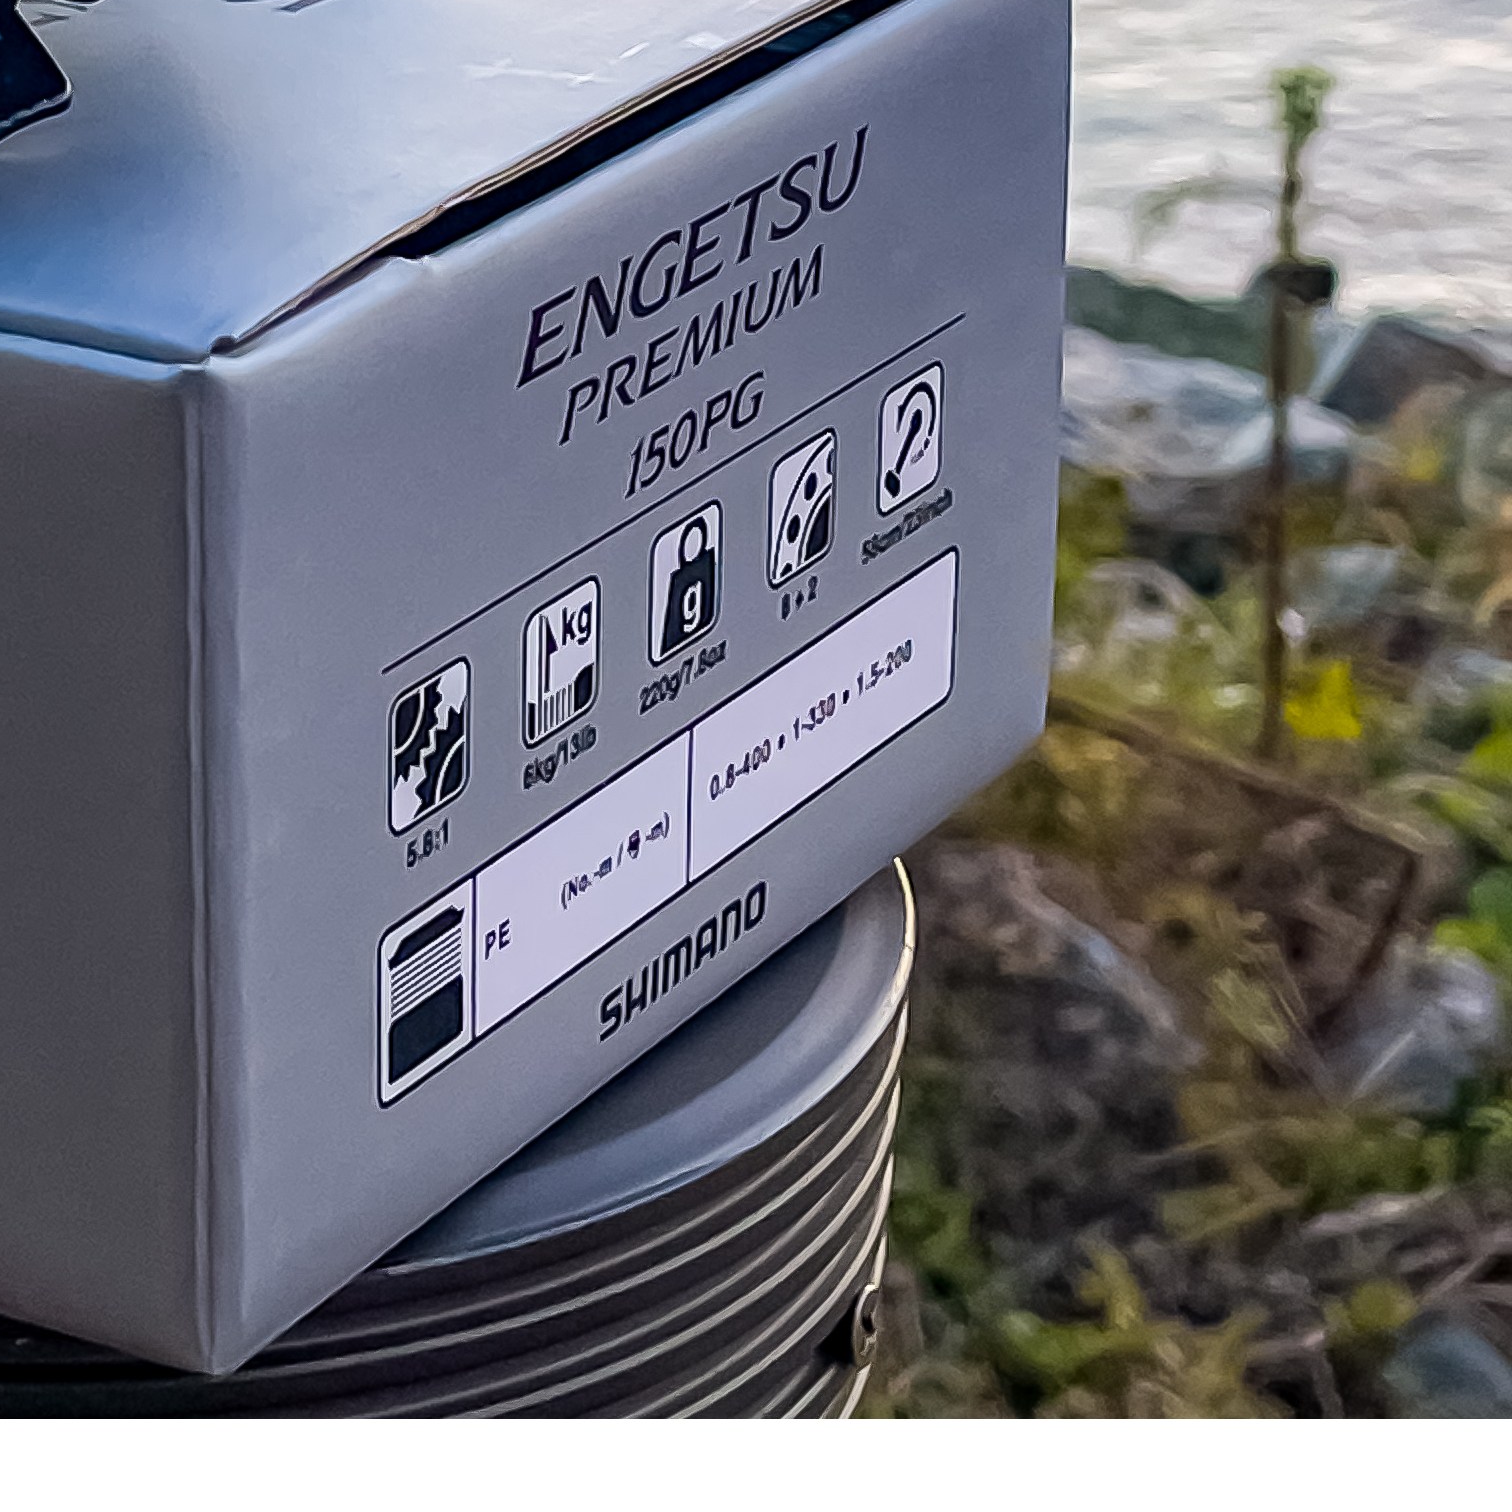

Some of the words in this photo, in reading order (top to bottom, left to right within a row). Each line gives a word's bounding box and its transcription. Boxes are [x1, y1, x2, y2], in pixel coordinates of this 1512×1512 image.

[516, 123, 869, 389] ENGETSU
[558, 245, 825, 447] PREMIUM
[624, 369, 765, 499] 150PG
[561, 600, 593, 646] kg
[484, 918, 510, 961] PE
[599, 880, 767, 1043] SHIMANO
